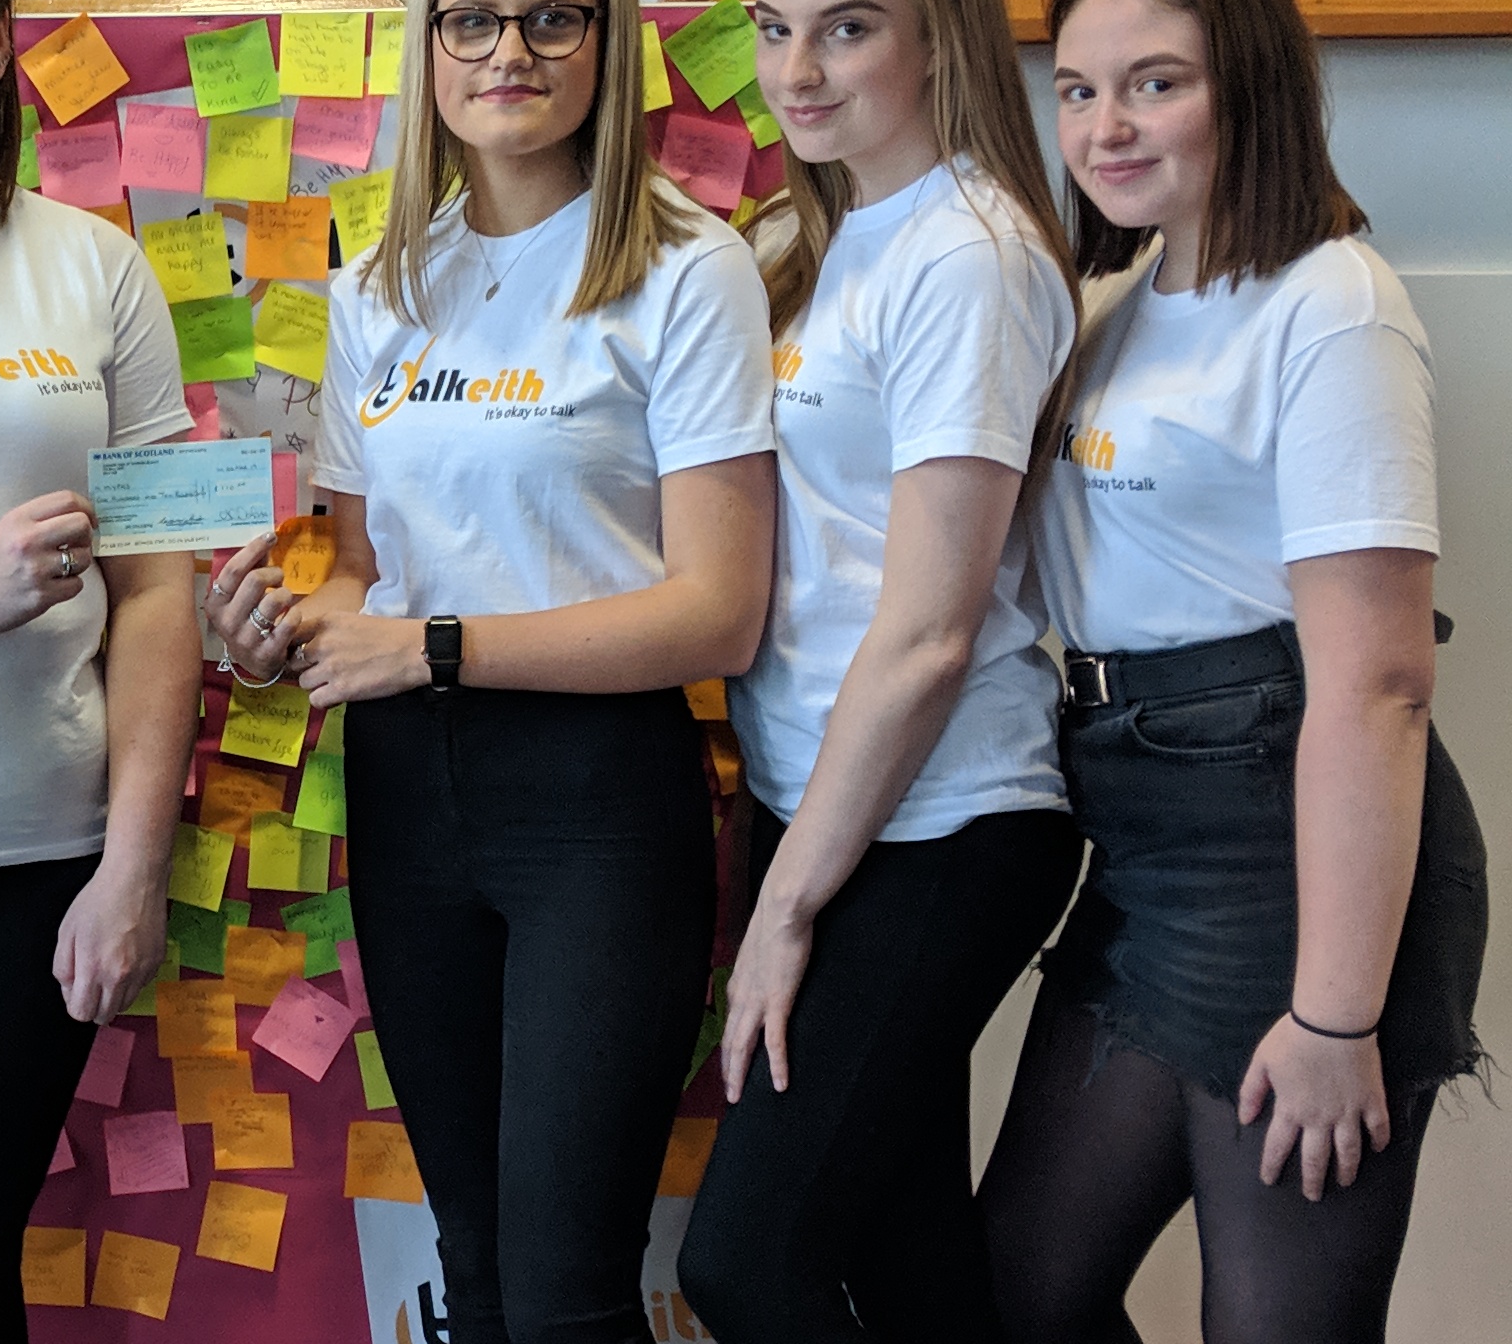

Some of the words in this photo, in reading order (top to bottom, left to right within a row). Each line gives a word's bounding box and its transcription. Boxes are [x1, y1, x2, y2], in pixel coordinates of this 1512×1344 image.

[61, 379, 84, 395] okay
[799, 391, 825, 408] talk
[484, 408, 503, 421] It's
[504, 406, 531, 421] okay
[534, 406, 547, 418] to
[550, 404, 577, 418] talk
[102, 450, 123, 461] BANK
[124, 450, 133, 460] OF
[134, 448, 175, 459] SCOTLAND
[1110, 478, 1126, 492] to
[1128, 477, 1157, 492] talk
